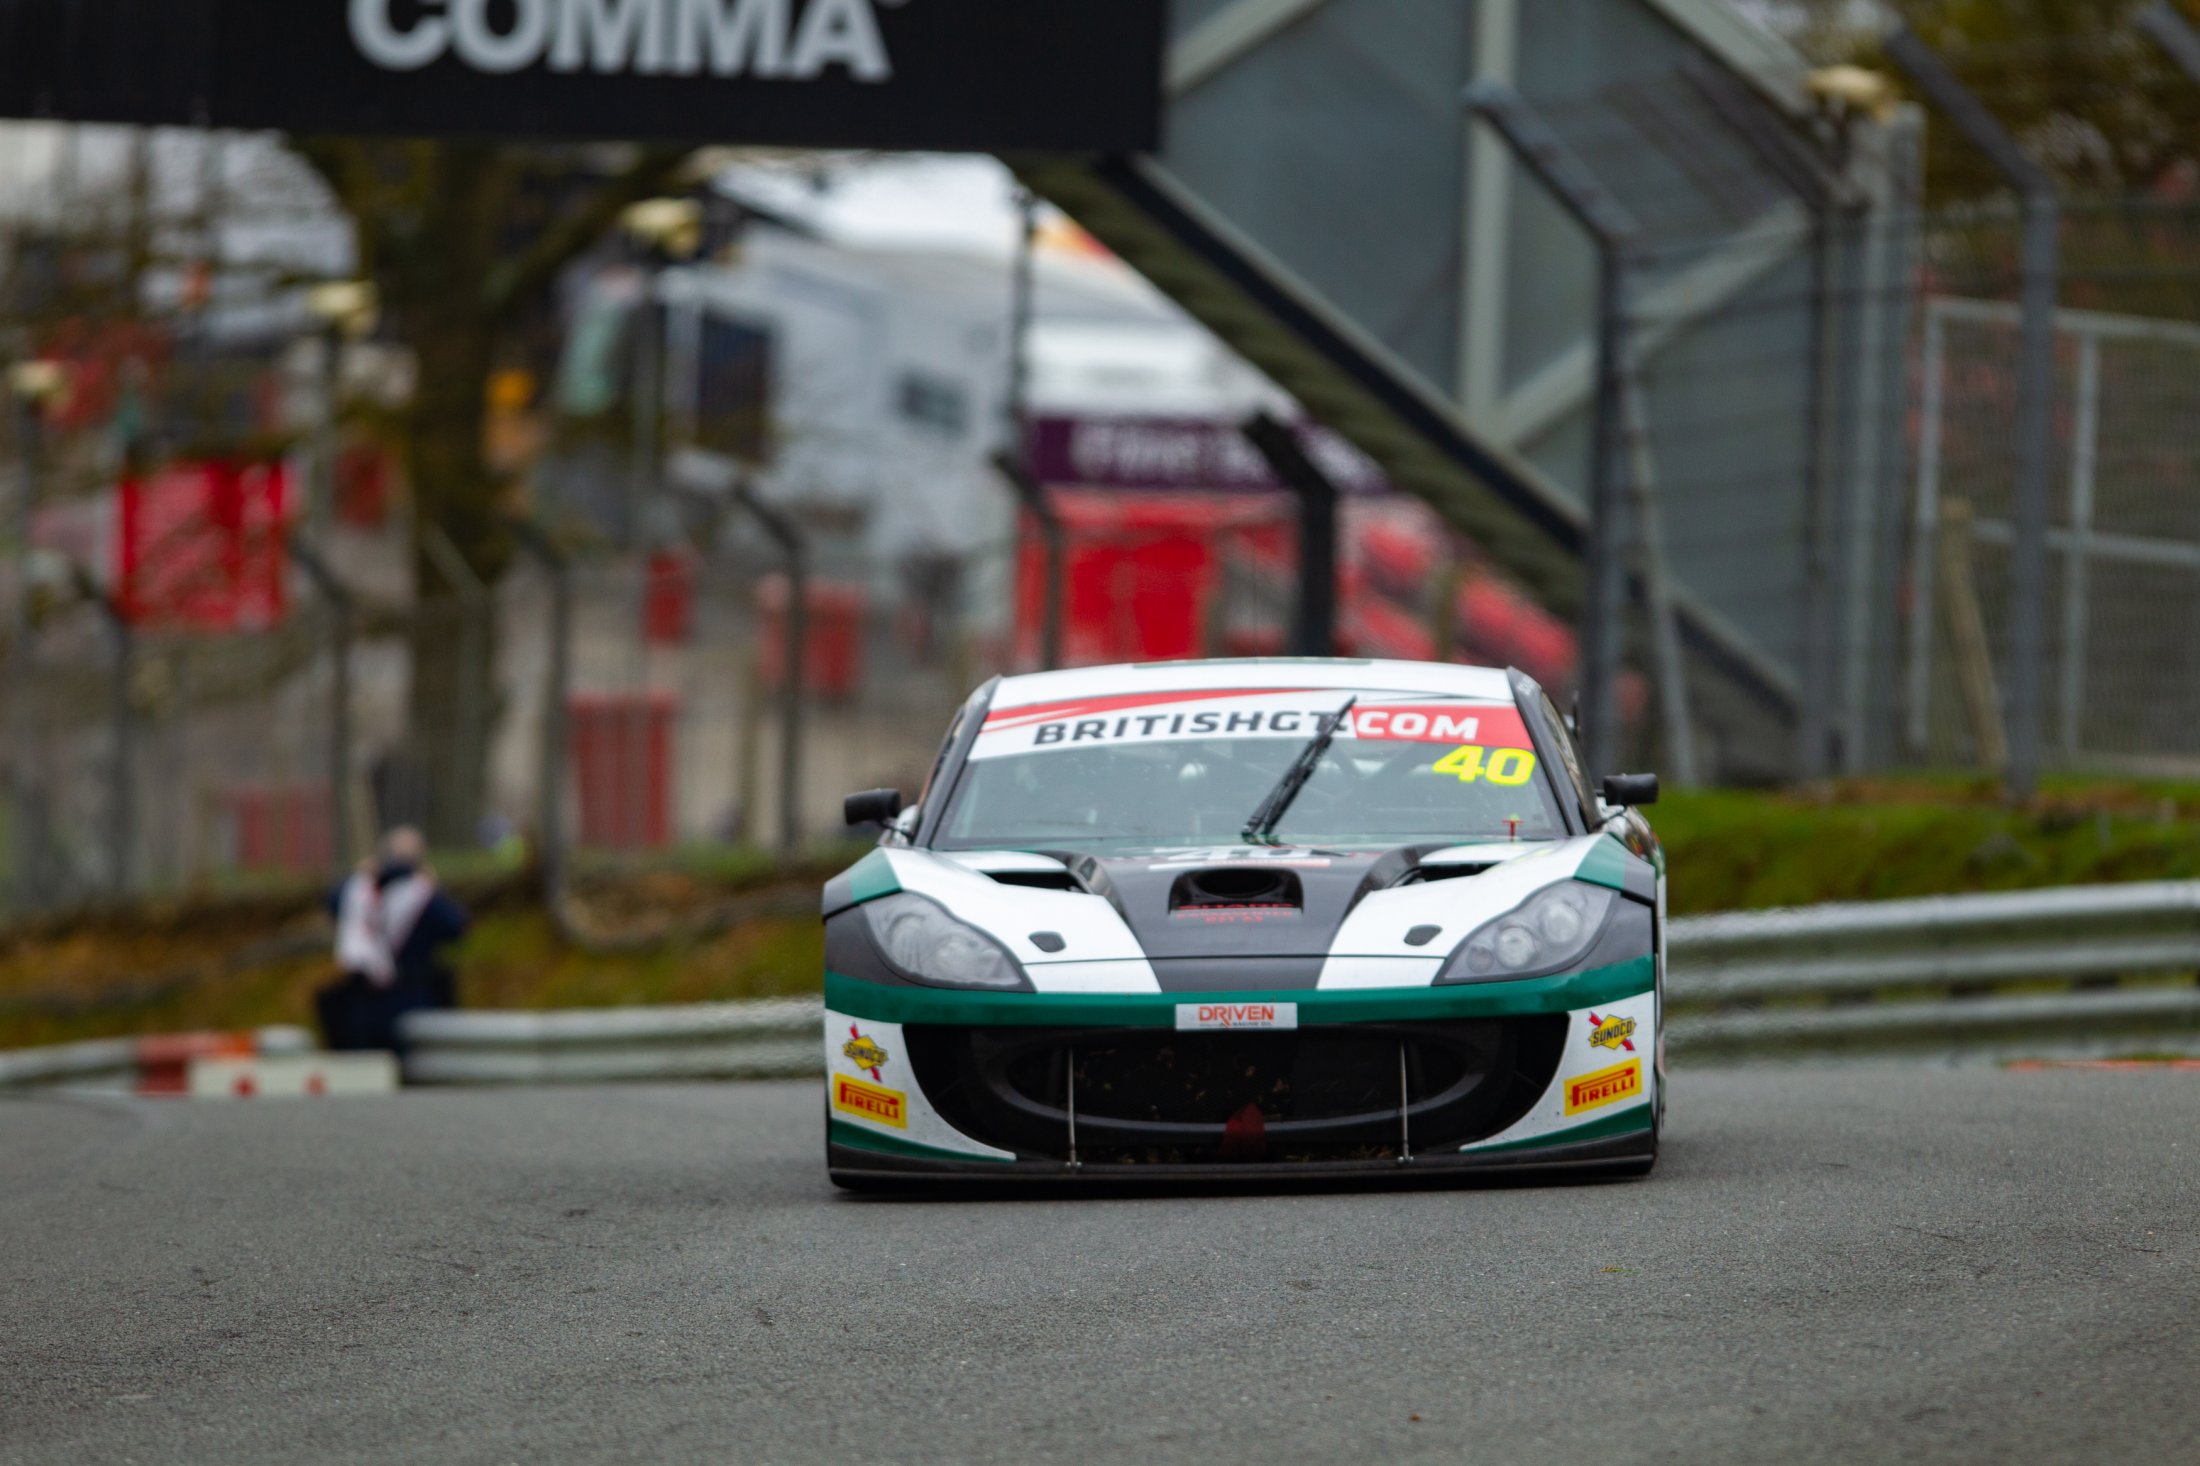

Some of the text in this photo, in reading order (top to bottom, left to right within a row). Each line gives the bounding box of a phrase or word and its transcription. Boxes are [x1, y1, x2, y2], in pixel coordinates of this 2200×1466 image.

[347, 0, 892, 82] COMMA
[1432, 744, 1537, 786] 40
[1199, 1005, 1275, 1027] DRIVEN
[1592, 1019, 1633, 1045] SUNOCO
[840, 1081, 899, 1119] PIRELLI
[1572, 1067, 1635, 1107] PIRELLI
